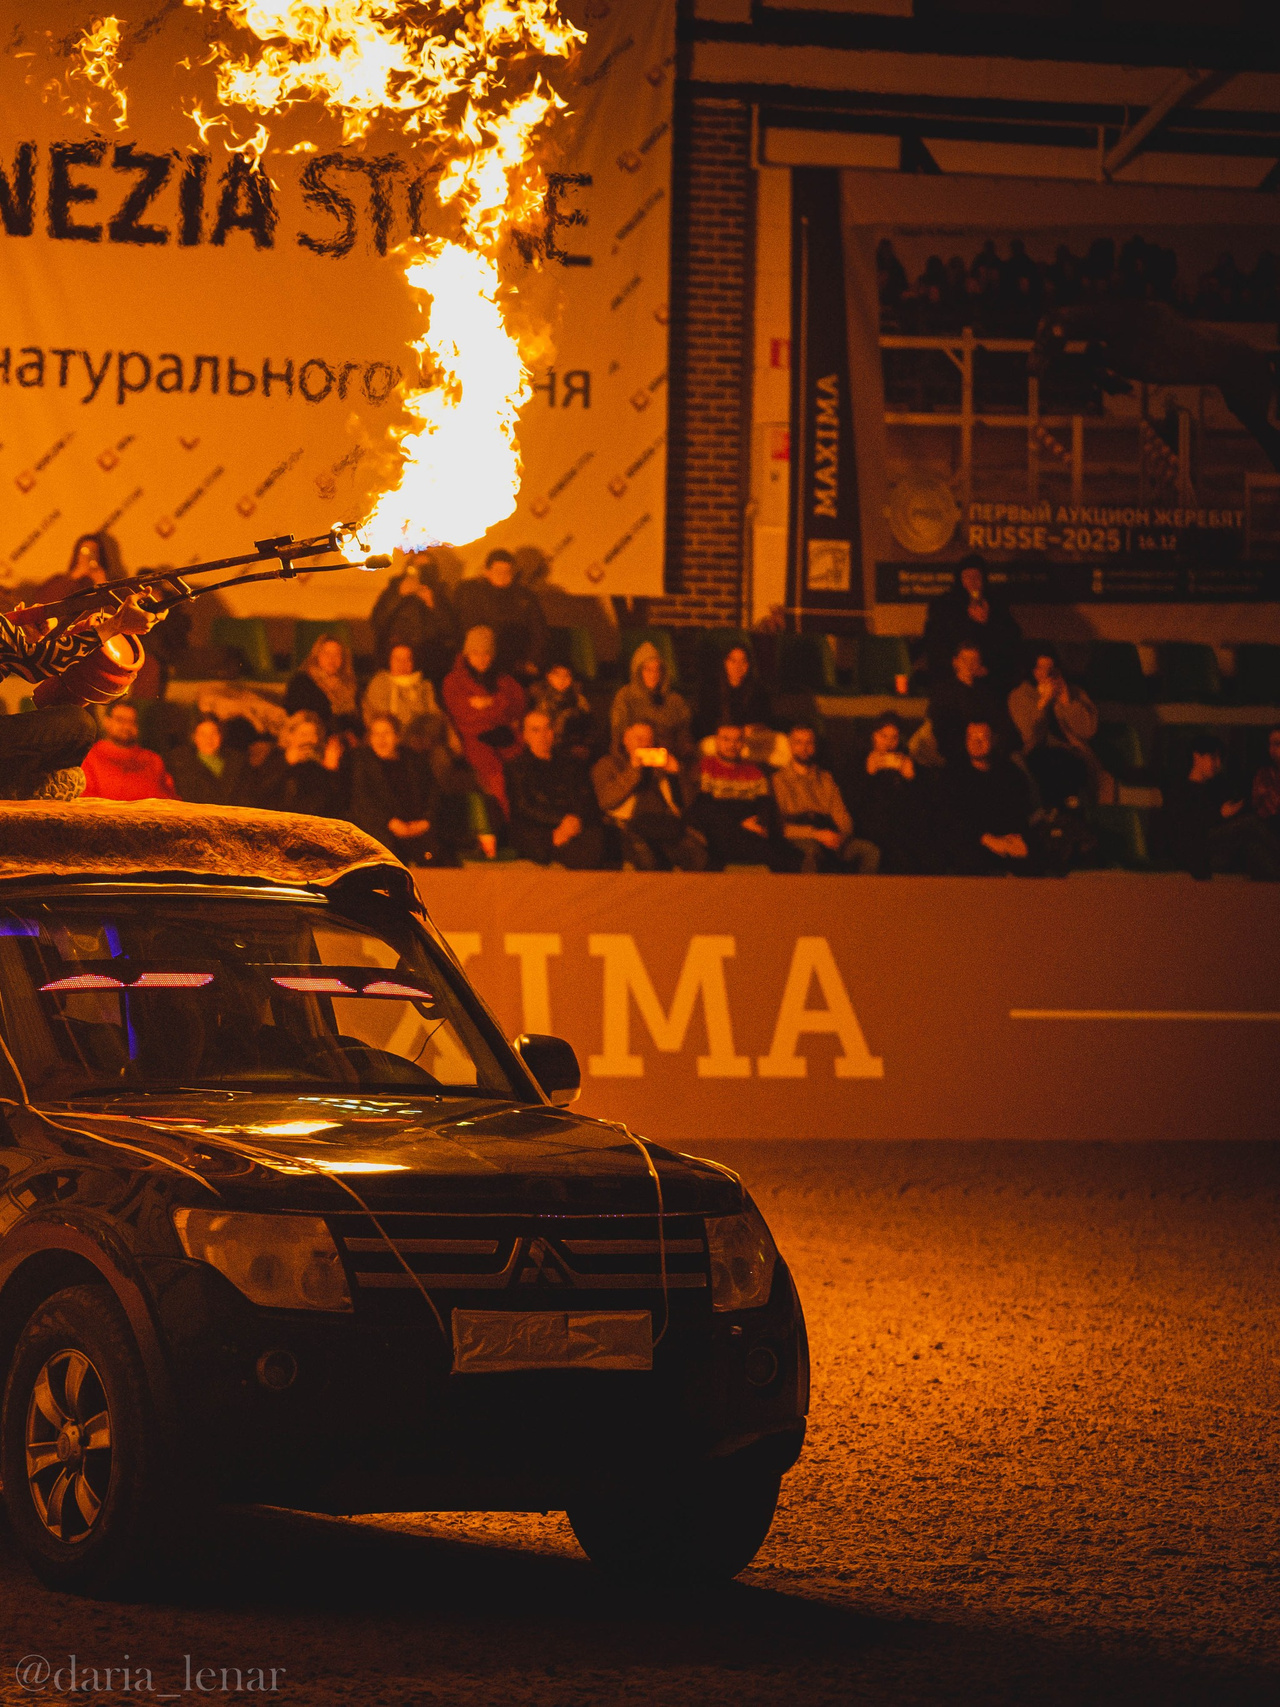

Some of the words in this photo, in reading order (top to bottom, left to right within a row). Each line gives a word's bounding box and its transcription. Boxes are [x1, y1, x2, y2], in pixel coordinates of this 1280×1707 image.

[813, 372, 839, 519] MAXIMA
[970, 500, 1052, 524] ПЕРВЫЙ
[1056, 504, 1150, 528] АУКЦИОН
[1154, 508, 1243, 529] ЖЕРЕБЯТ
